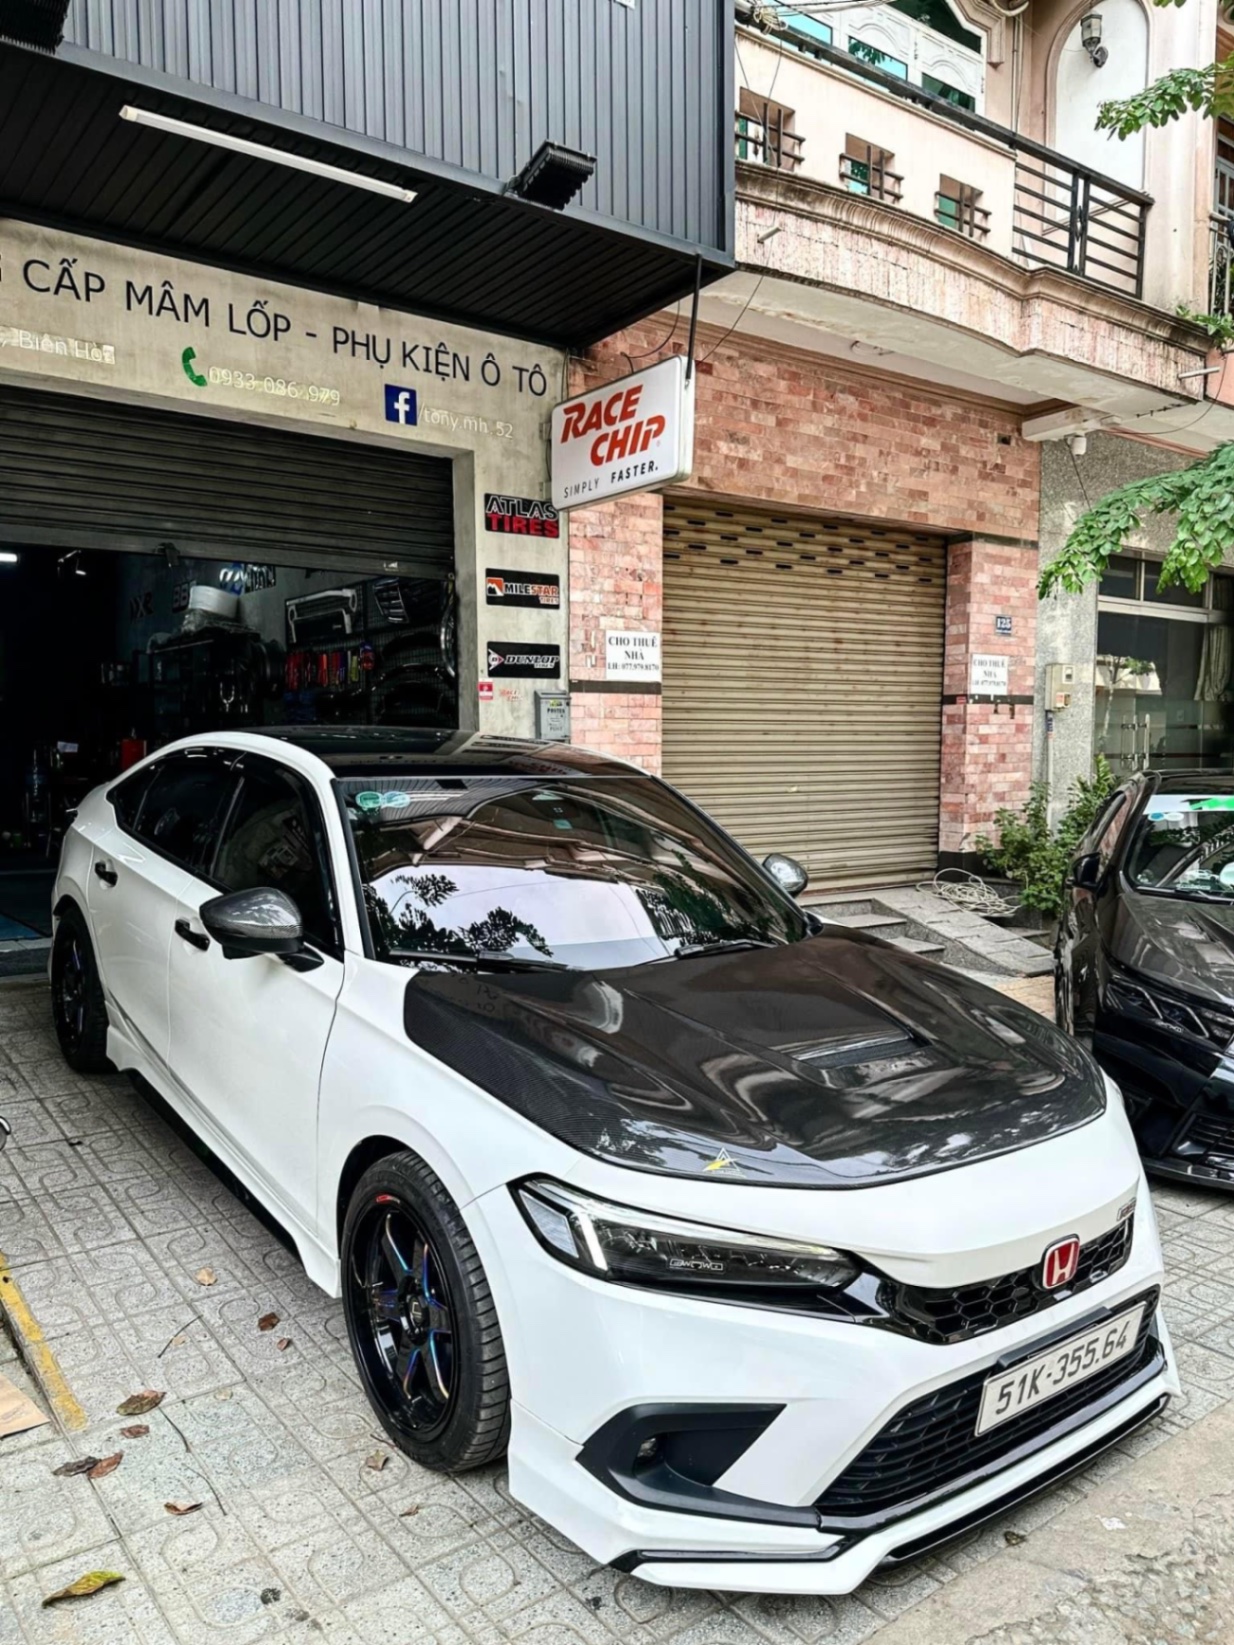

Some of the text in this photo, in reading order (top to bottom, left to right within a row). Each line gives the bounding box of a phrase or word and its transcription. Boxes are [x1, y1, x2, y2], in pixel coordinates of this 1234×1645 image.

[23, 257, 105, 302] CẤP
[125, 280, 210, 327] MÂM
[228, 300, 291, 341] LỐP
[332, 326, 391, 370] PHỤ
[402, 342, 470, 382] KIỆN
[481, 353, 501, 387] Ô
[512, 363, 548, 397] TÔ
[560, 384, 644, 444] RACE
[590, 414, 666, 467] CHIP
[563, 478, 600, 499] SIMPLY
[486, 495, 559, 521] ATLAS
[487, 513, 558, 537] TIRES
[504, 582, 559, 596] MILESTAR
[608, 636, 630, 646] CHO
[504, 654, 560, 665] DUNLOP
[995, 1320, 1132, 1415] 51K-355.64
